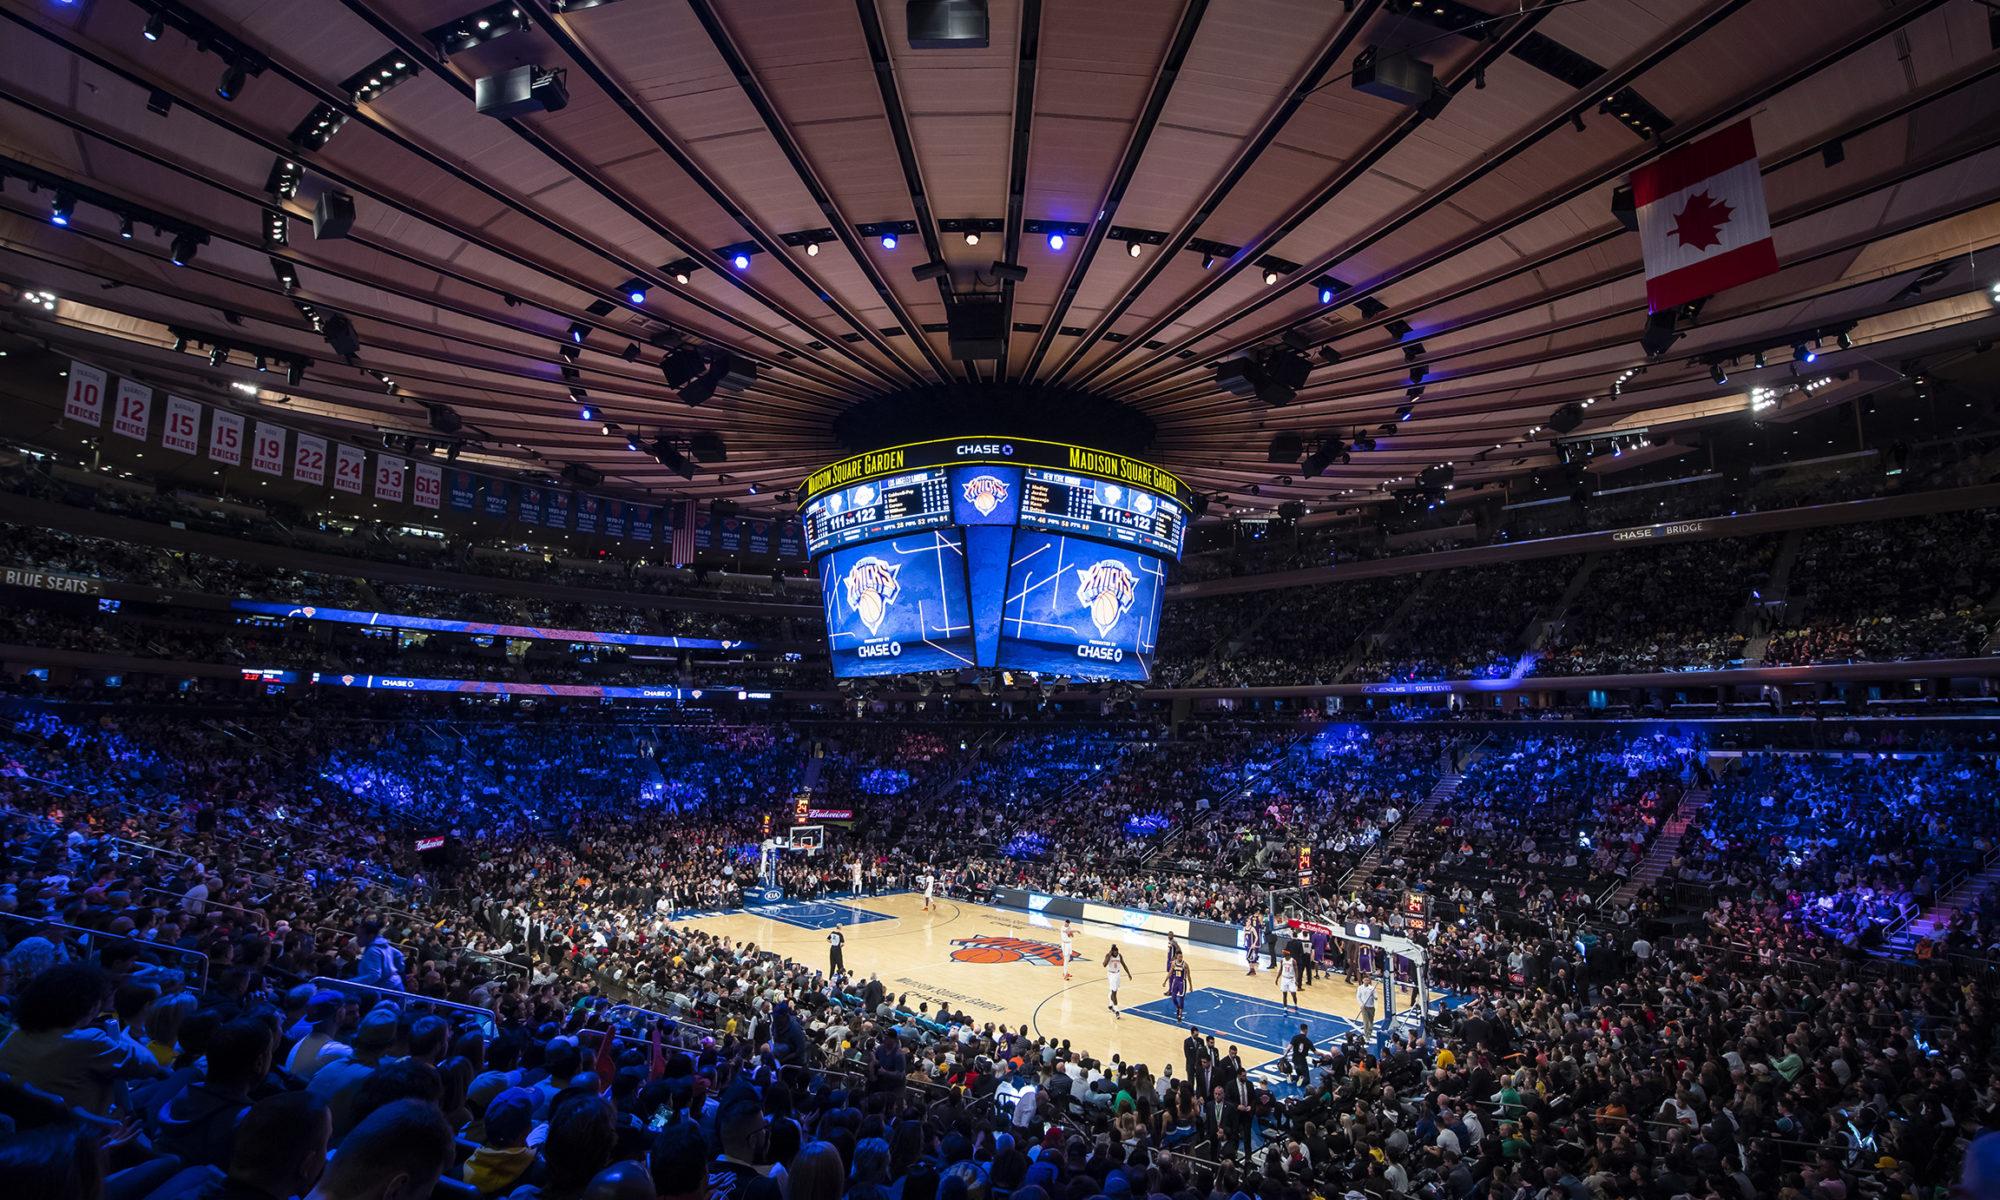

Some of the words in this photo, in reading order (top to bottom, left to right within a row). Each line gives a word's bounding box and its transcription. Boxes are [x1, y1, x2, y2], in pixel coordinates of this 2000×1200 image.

[74, 381, 98, 406] 10
[67, 404, 100, 422] KNICKS
[122, 397, 145, 422] 12
[115, 420, 145, 436] KNICKS
[171, 413, 194, 436] 15
[165, 435, 195, 450] KNICKS
[216, 426, 237, 448] 15
[211, 447, 239, 461] KNICKS
[259, 438, 279, 458] 19
[957, 444, 1000, 455] CHASE
[255, 458, 281, 471] KNICKS
[299, 448, 323, 469] 22
[296, 469, 322, 481] KNICKS
[339, 458, 360, 479] 24
[808, 470, 831, 495] MADISON
[833, 459, 862, 484] SQUARE
[865, 450, 904, 475] GARDEN
[1070, 448, 1117, 476] MADISON
[1121, 458, 1152, 485] SQUARE
[1154, 471, 1177, 497] GARDEN
[336, 478, 360, 490] KNICKS
[379, 468, 402, 488] 33
[416, 476, 440, 495] 613
[377, 487, 401, 498] KNICKS
[416, 495, 438, 505] KNICKS
[831, 515, 845, 530] 111
[856, 508, 876, 523] 122
[1100, 508, 1120, 523] 111
[1134, 515, 1150, 531] 122
[1612, 529, 1652, 541] CHASE
[1666, 522, 1703, 535] BRIDGE
[6, 570, 43, 588] BLUE
[47, 576, 88, 594] SEATS
[858, 643, 890, 657] CHASE
[1077, 645, 1113, 661] CHASE
[382, 683, 408, 691] CHASE
[644, 690, 666, 698] CHASE
[797, 805, 807, 814] 24
[810, 809, 850, 819] Budweiser
[415, 840, 444, 851] Budweiser
[1299, 856, 1309, 869] 24
[1409, 903, 1420, 911] 24
